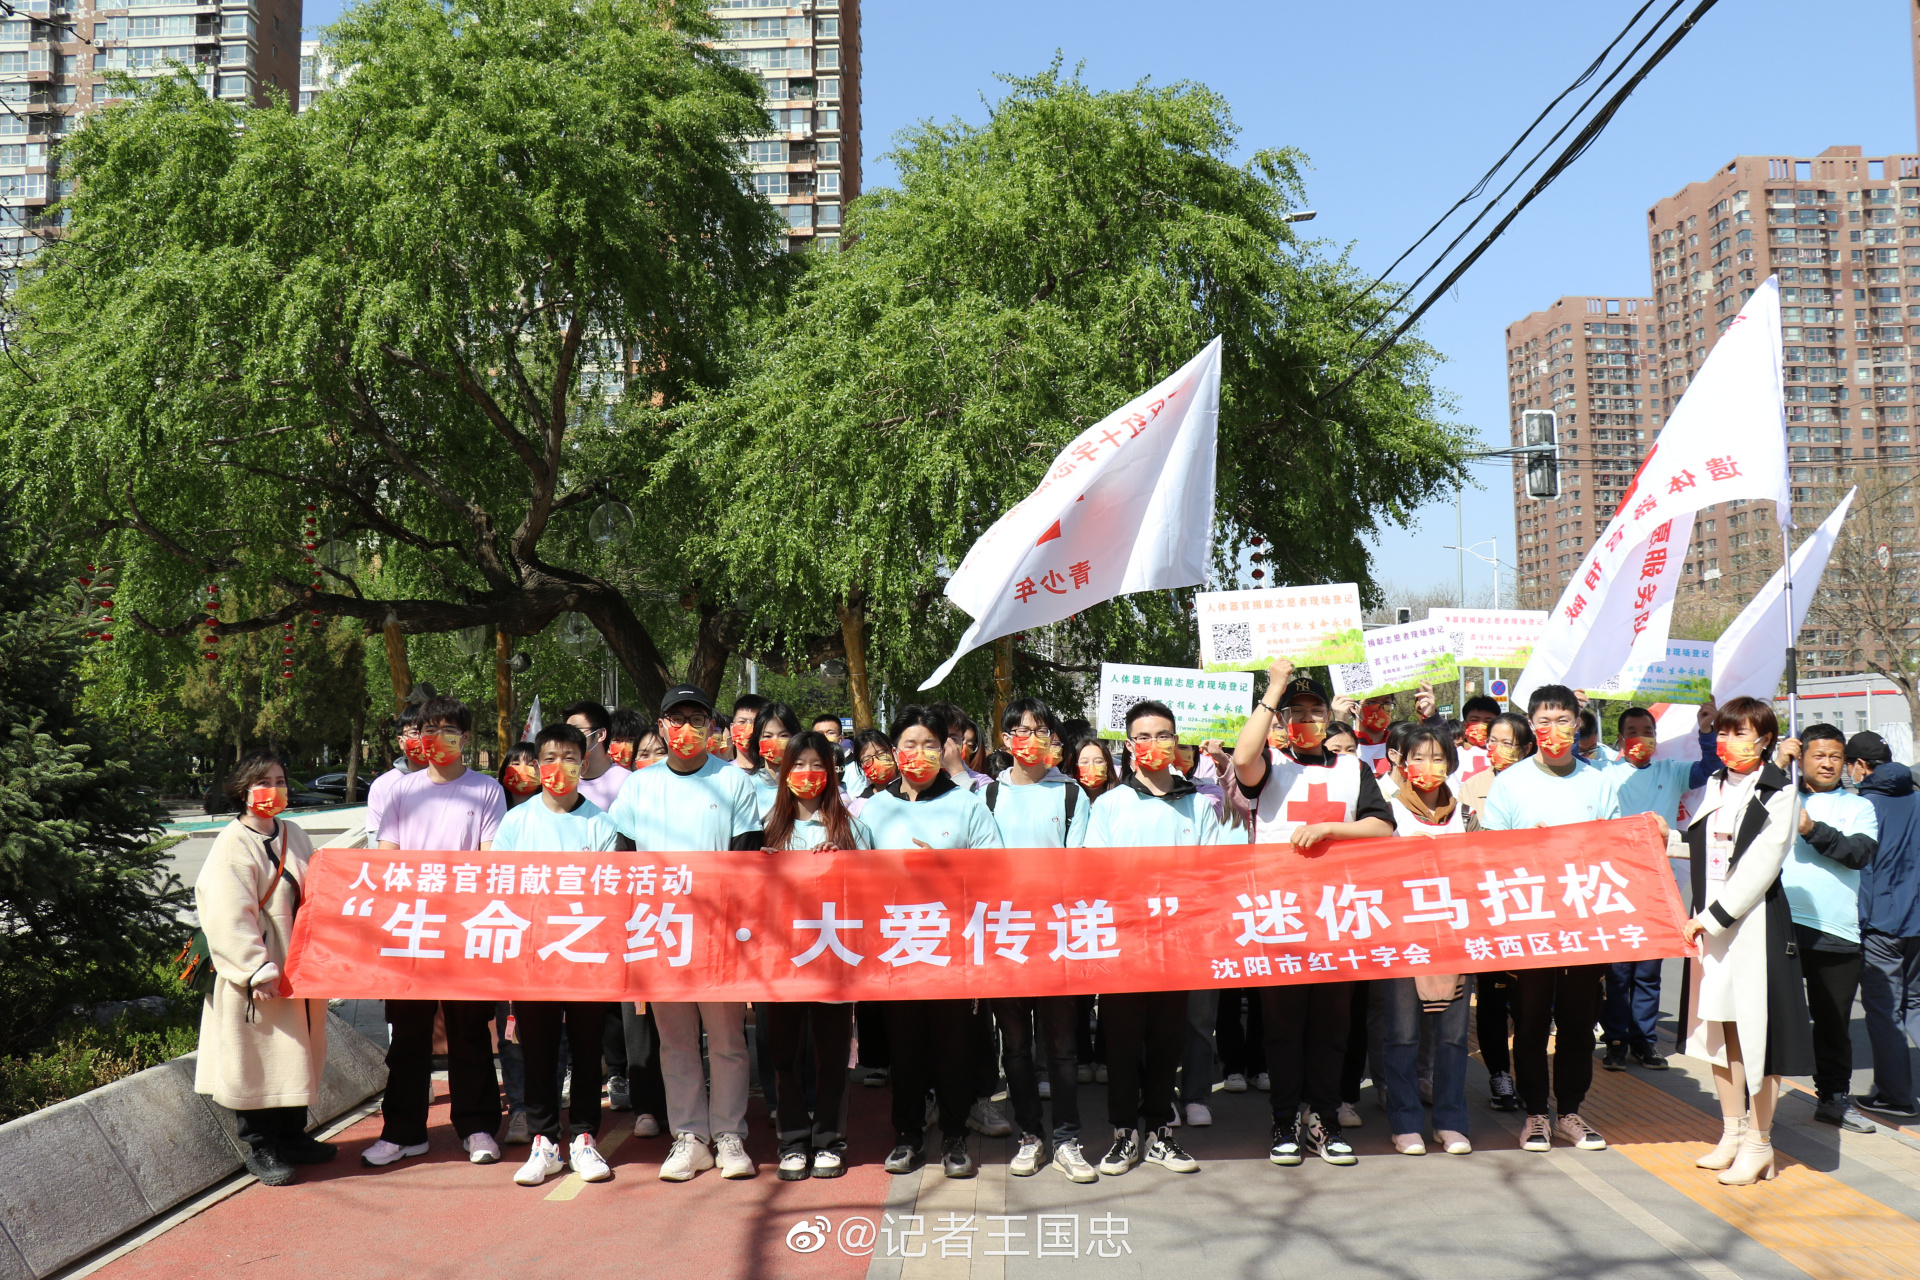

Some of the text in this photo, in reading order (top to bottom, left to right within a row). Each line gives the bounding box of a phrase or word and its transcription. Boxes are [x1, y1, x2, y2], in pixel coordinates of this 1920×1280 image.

[1207, 594, 1354, 613] 人体器官捐献志愿者现场登记
[1366, 625, 1445, 648] 捐献志愿者现场登记
[1110, 674, 1249, 693] 人体器官捐献志愿者现场登记
[1163, 699, 1244, 714] 官捐献 生命永续
[348, 862, 695, 897] 人体器官捐献宣传活动
[1234, 861, 1638, 947] 迷你马拉松
[1211, 924, 1649, 980] 沈阳市红十字会 铁西区红十字
